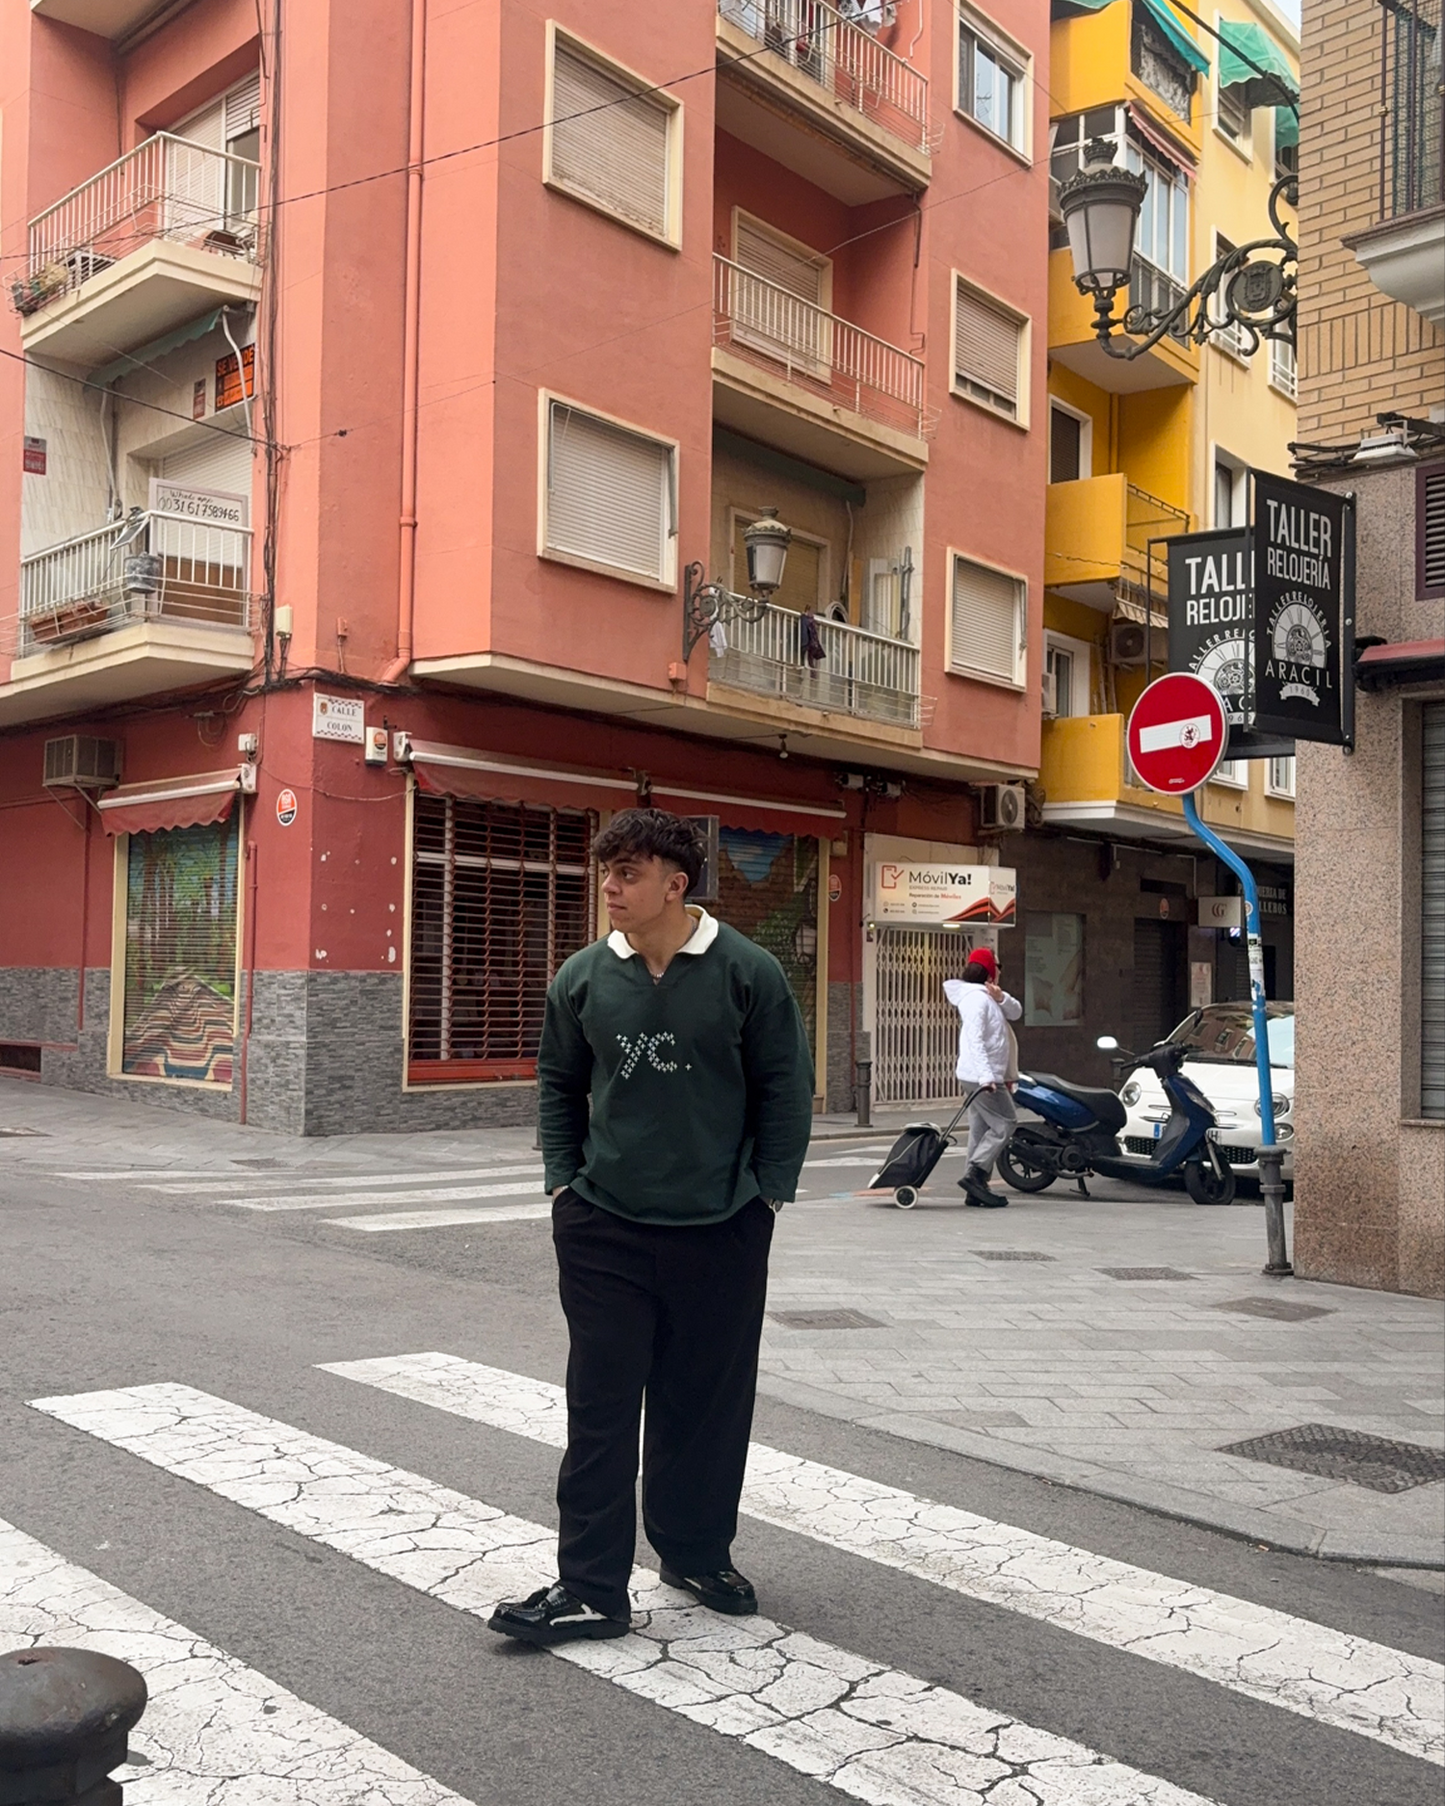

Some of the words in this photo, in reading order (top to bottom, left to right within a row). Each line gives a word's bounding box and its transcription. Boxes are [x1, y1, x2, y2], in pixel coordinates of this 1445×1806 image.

[228, 345, 255, 371] VEDE
[1266, 498, 1332, 558] TALLER
[1267, 555, 1331, 591] RELOJERÍA
[1188, 634, 1221, 671] ALLER
[1265, 659, 1332, 689] ARACIL
[1289, 685, 1311, 698] 1960
[332, 705, 357, 716] CALLE
[908, 871, 972, 886] MóvilYa!
[908, 892, 934, 900] Reparación
